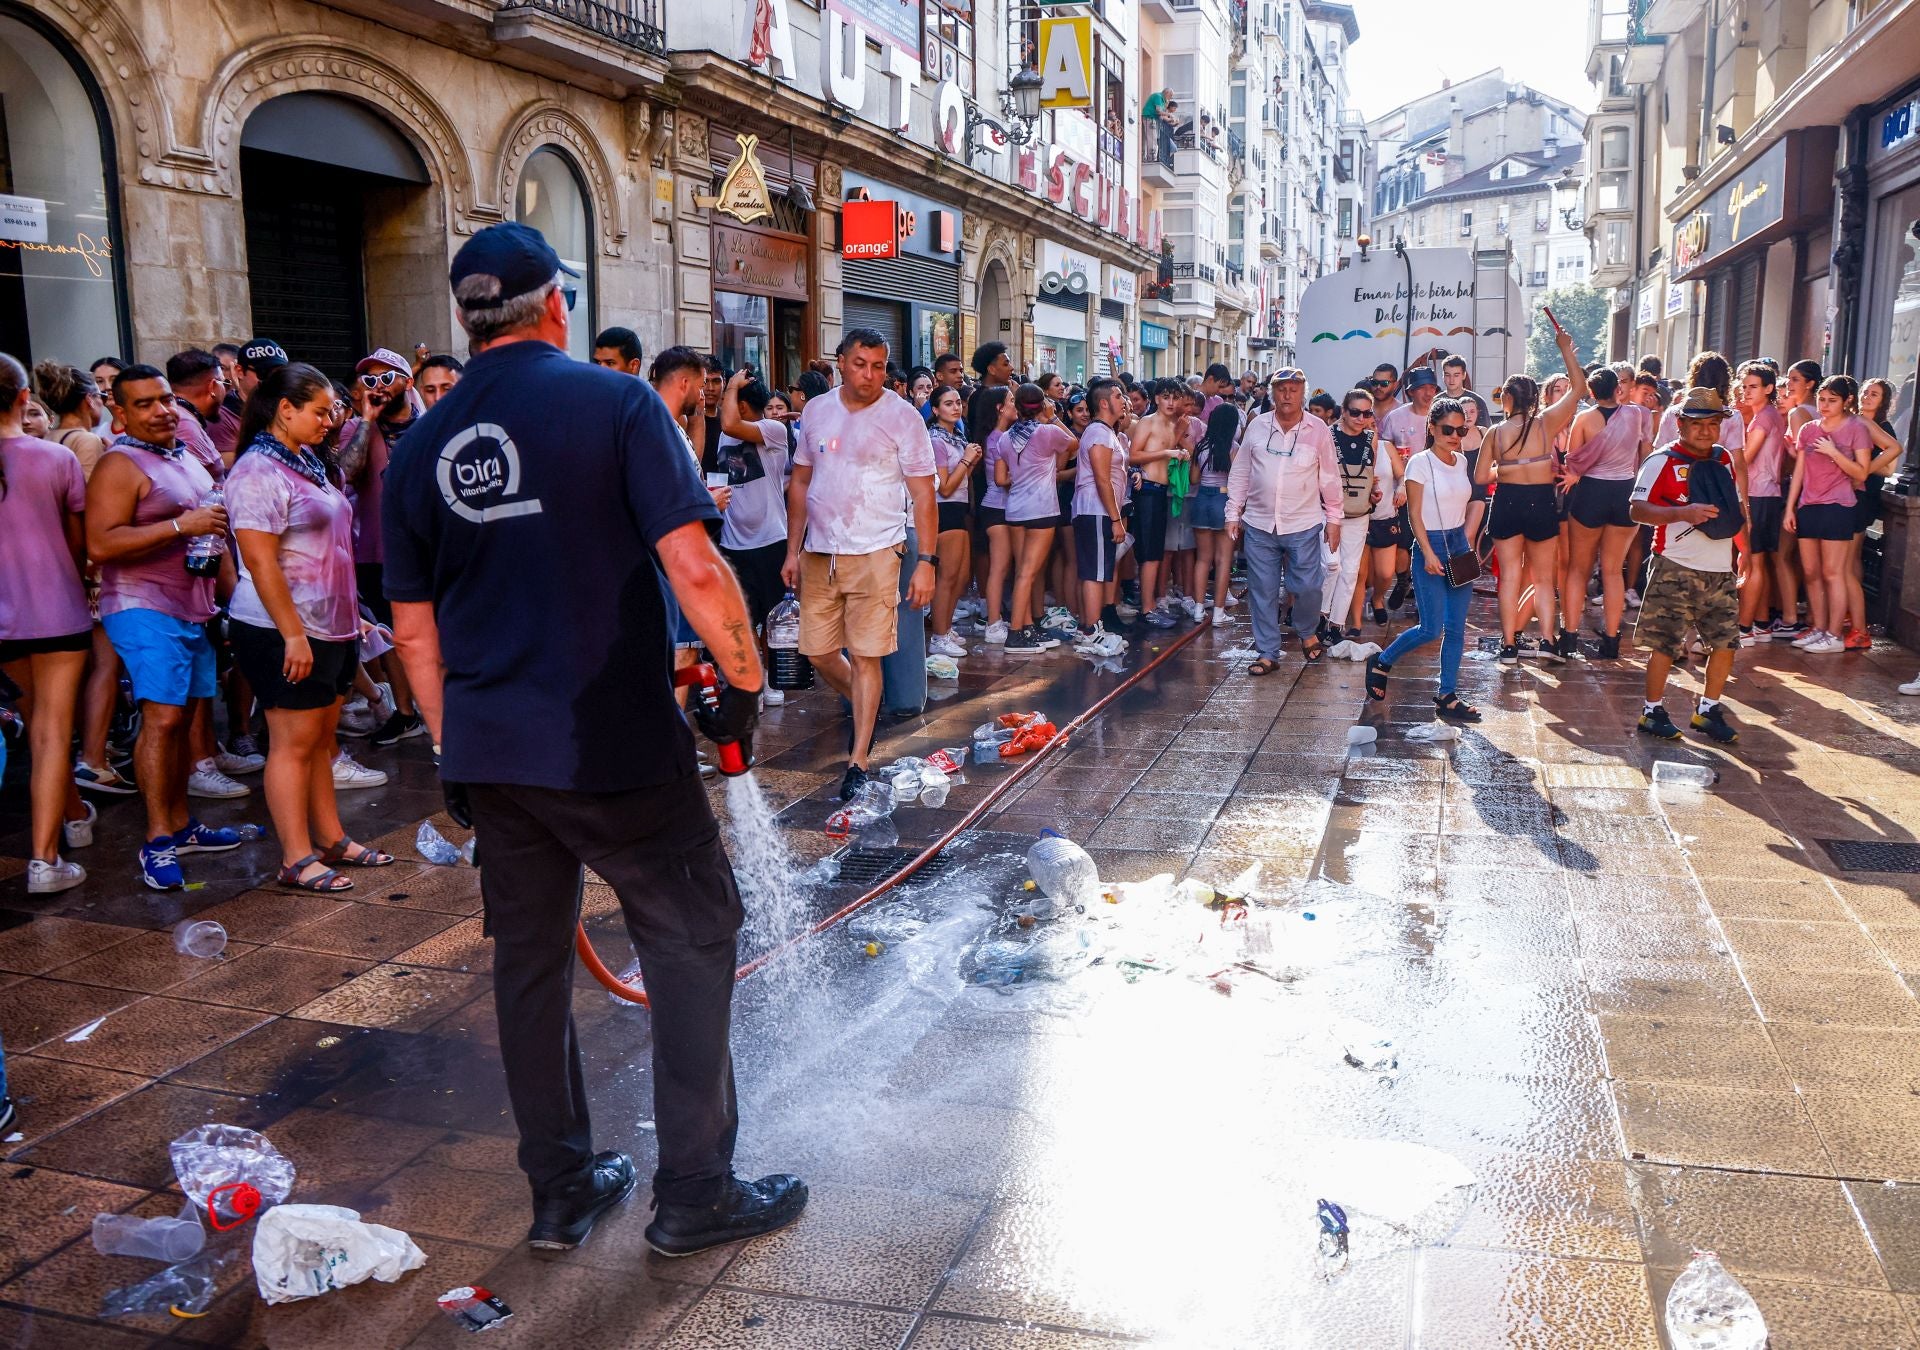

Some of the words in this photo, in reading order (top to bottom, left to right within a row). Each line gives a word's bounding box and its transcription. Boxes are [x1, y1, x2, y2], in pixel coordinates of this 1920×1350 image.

[845, 241, 889, 256] orange
[1354, 287, 1394, 303] Eman
[1395, 282, 1427, 301] bete
[1428, 280, 1456, 300] bira
[1456, 280, 1474, 299] bat
[1375, 303, 1405, 324] Dale
[1429, 303, 1457, 322] bira
[1001, 320, 1010, 330] 18
[455, 456, 502, 486] bira
